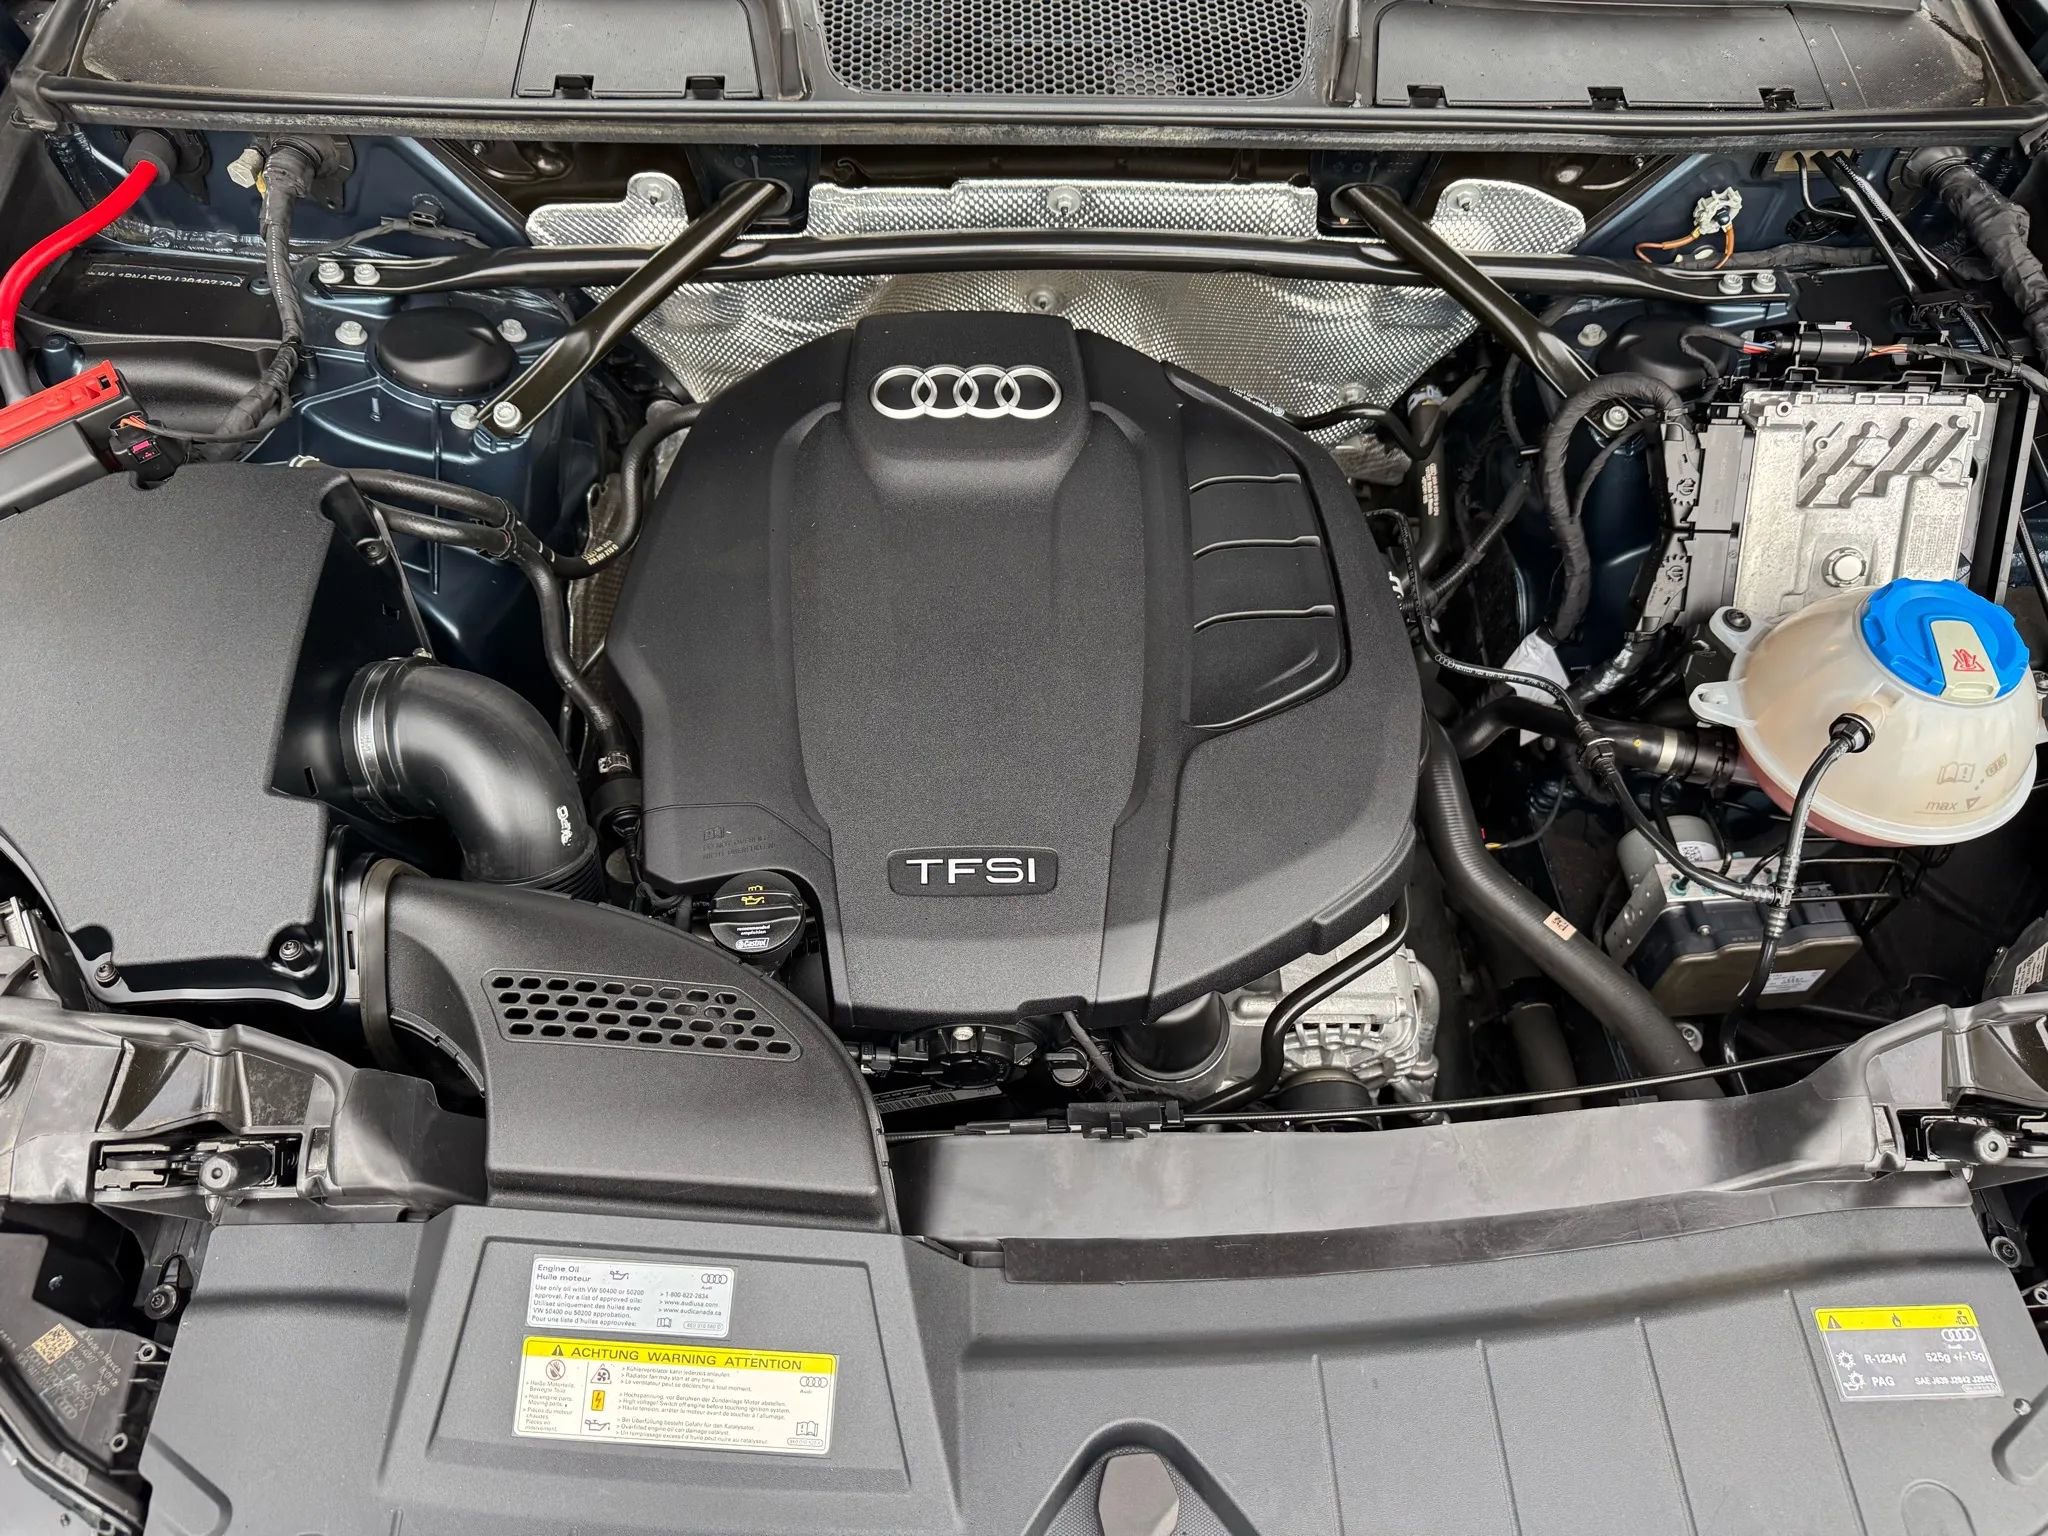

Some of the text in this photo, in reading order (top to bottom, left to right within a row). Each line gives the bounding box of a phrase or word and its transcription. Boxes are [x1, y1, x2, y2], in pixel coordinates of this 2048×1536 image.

[1926, 801, 1958, 811] max
[905, 857, 1036, 884] TFSI
[537, 1264, 580, 1273] Engine Oil
[536, 1273, 558, 1281] Huile
[599, 1295, 628, 1303] approved
[664, 1300, 718, 1308] www.audiusa.com
[663, 1307, 722, 1316] www.audicanada.ca
[571, 1347, 802, 1370] ACHTUNG WARNING ATTENTION
[1864, 1351, 1986, 1365] R-1234yf 525g +/-15g
[1871, 1376, 1896, 1387] PAG
[1914, 1377, 1931, 1385] SAE
